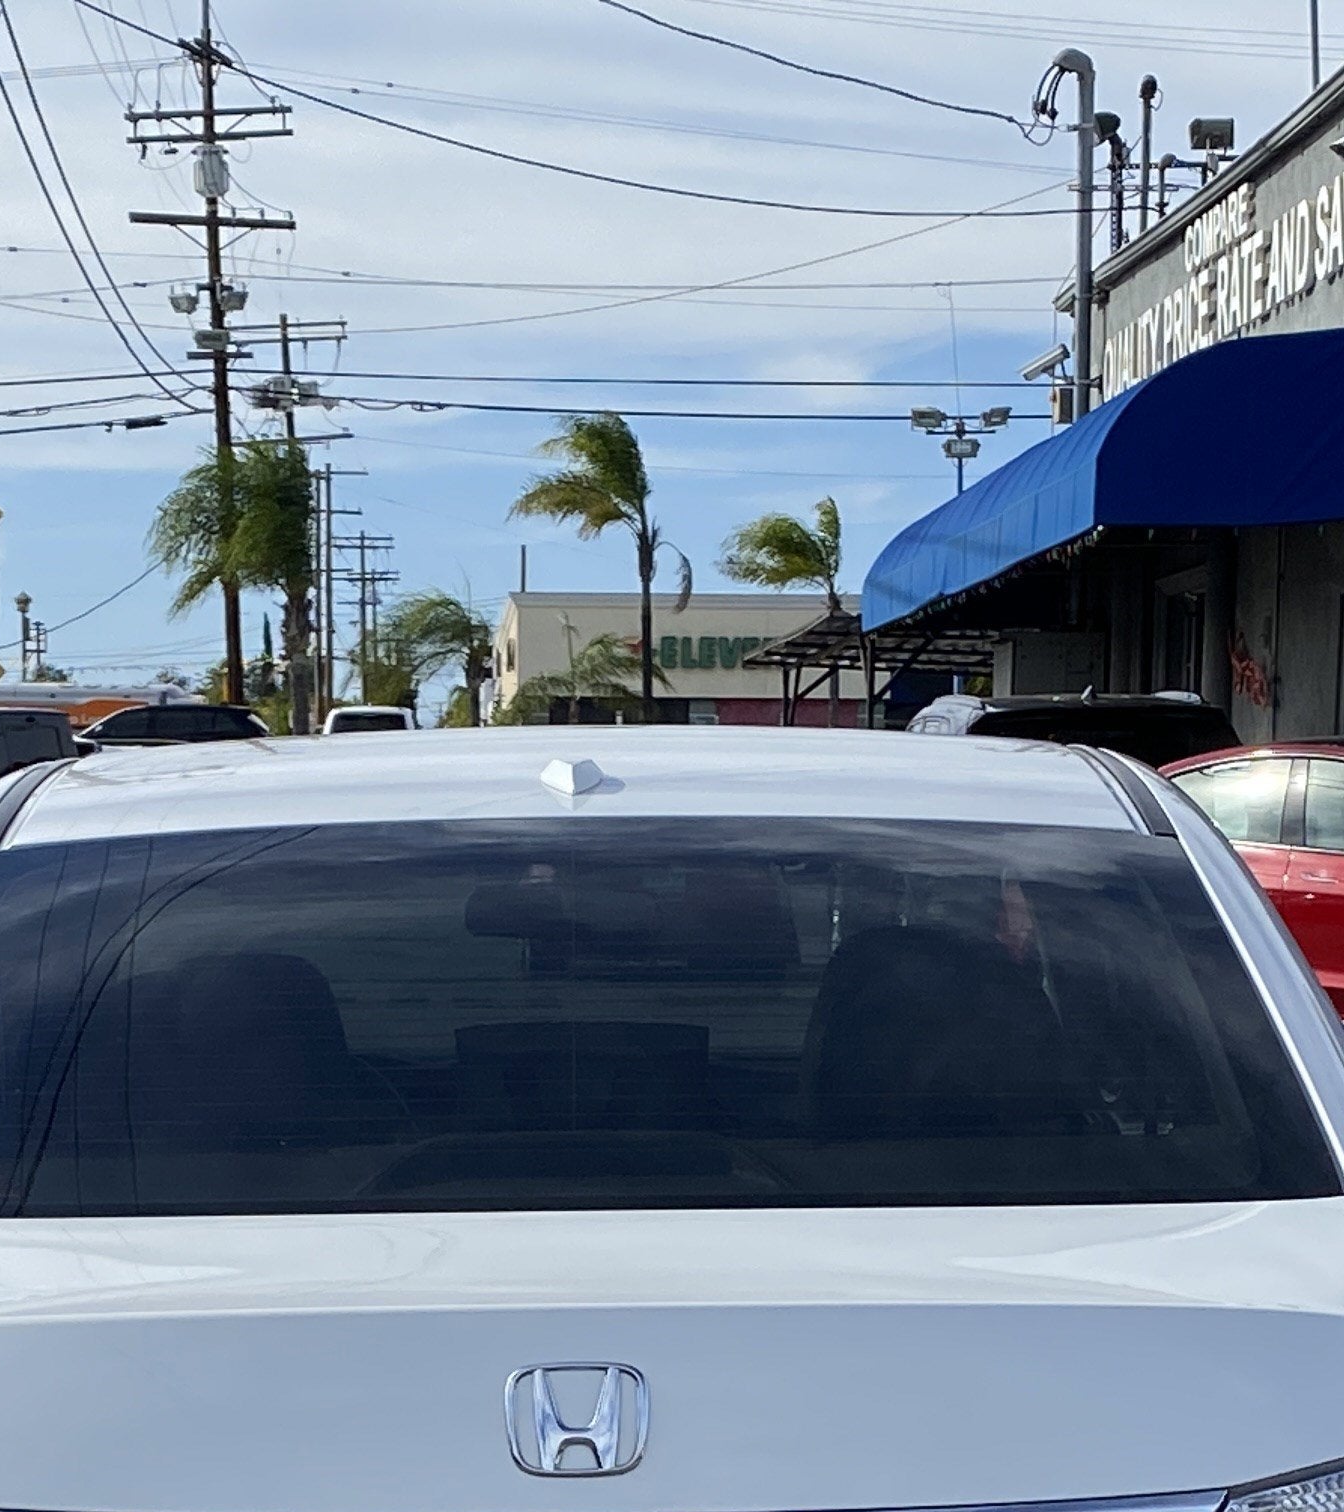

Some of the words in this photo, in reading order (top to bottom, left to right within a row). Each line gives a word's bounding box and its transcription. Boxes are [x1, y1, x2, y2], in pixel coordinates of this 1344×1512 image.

[1184, 182, 1250, 273] COMPARE
[1216, 230, 1265, 341] RATE
[1266, 199, 1310, 310] AND
